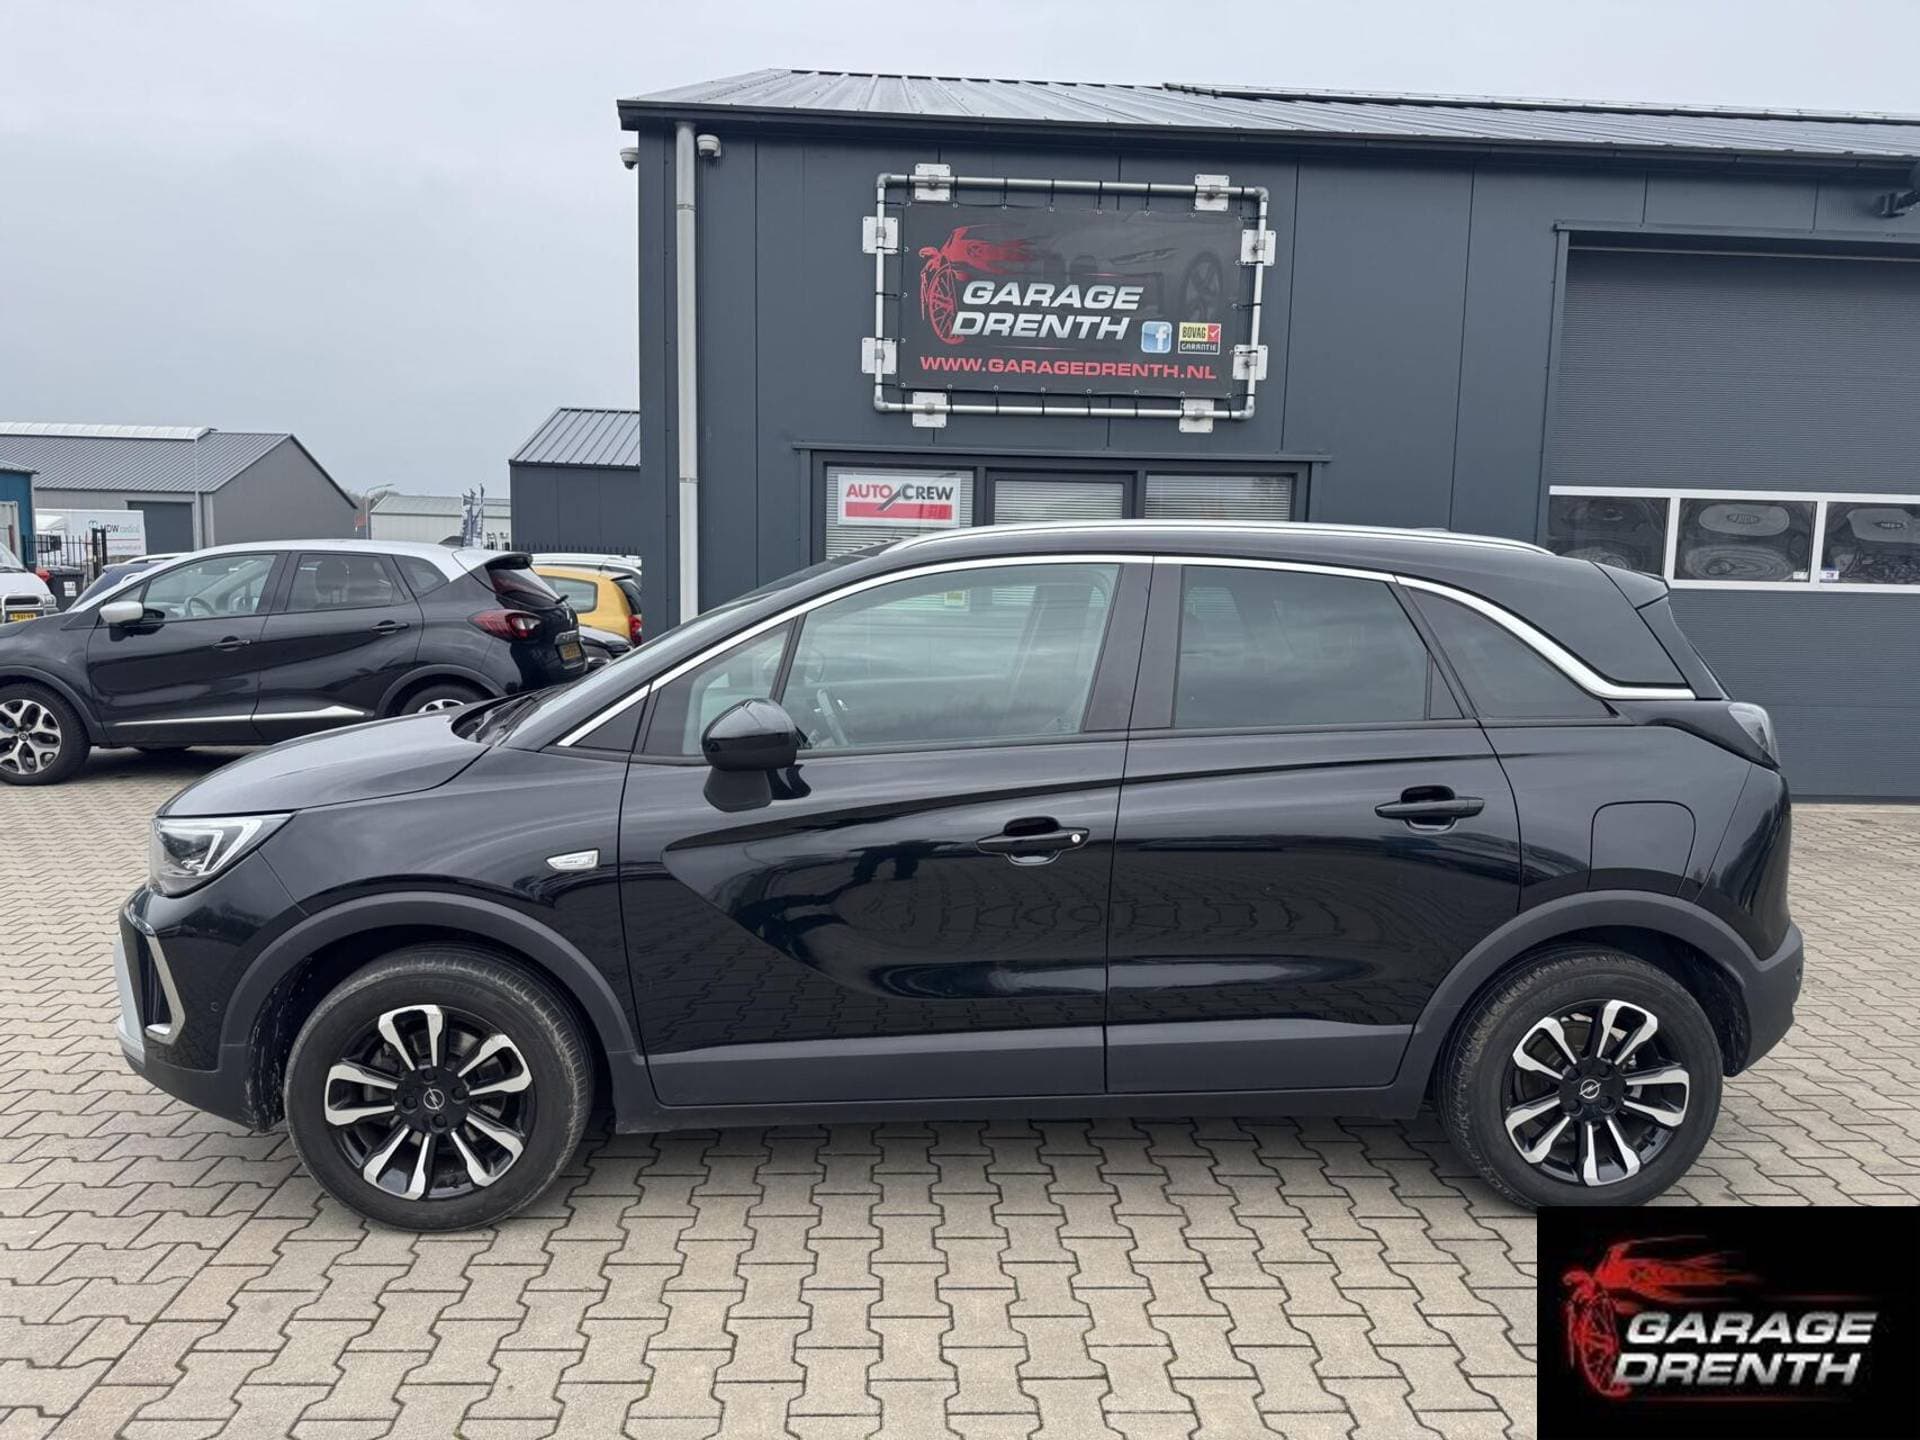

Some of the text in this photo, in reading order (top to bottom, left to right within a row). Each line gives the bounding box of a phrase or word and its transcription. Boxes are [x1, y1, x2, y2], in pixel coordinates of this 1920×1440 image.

[962, 280, 1145, 311] GARAGE
[950, 311, 1131, 341] DRENTH
[1182, 326, 1206, 339] BOVAG
[1181, 342, 1217, 352] GARANTIE
[919, 356, 1217, 380] WWW.GARAGEDRENTH.NL
